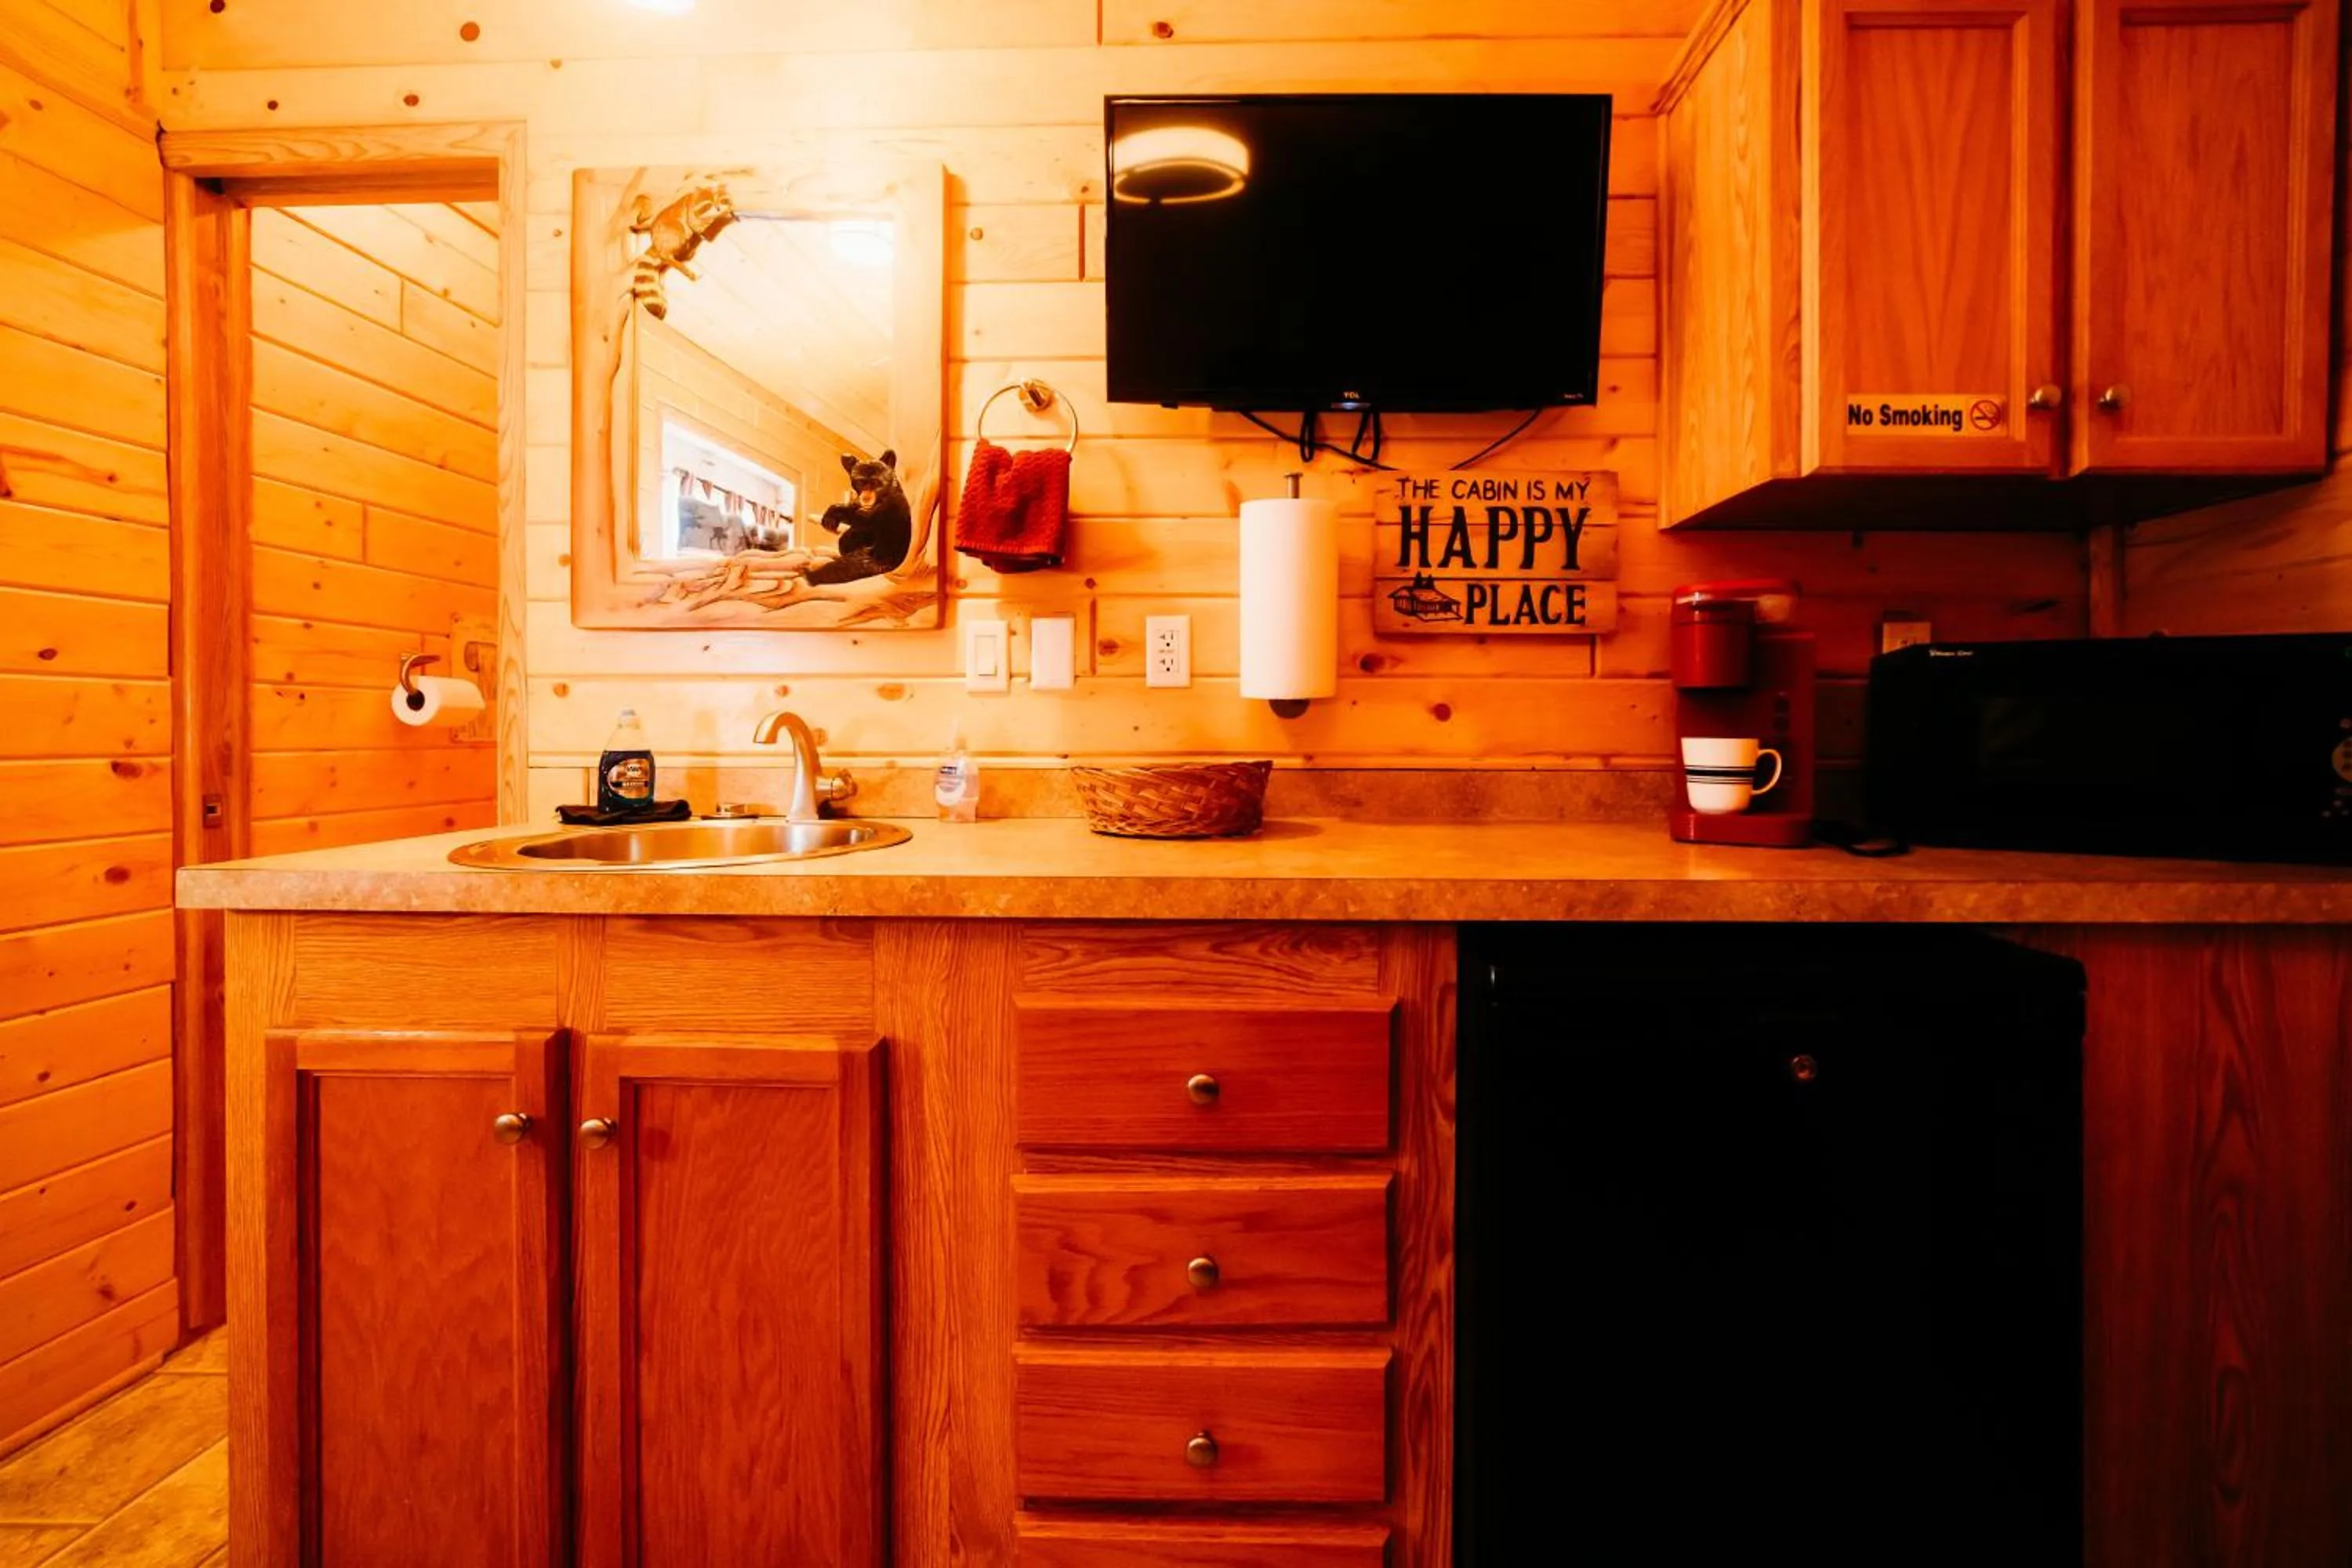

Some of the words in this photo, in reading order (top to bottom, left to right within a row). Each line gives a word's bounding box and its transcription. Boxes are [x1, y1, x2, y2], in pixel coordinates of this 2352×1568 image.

[1847, 404, 1874, 426] No
[1879, 403, 1963, 432] Smoking
[1396, 477, 1441, 499] THE
[1451, 478, 1519, 502] CABIN
[1526, 480, 1546, 501] IS
[1555, 477, 1591, 501] MY
[1396, 505, 1592, 571] HAPPY
[1465, 583, 1587, 626] PLACE
